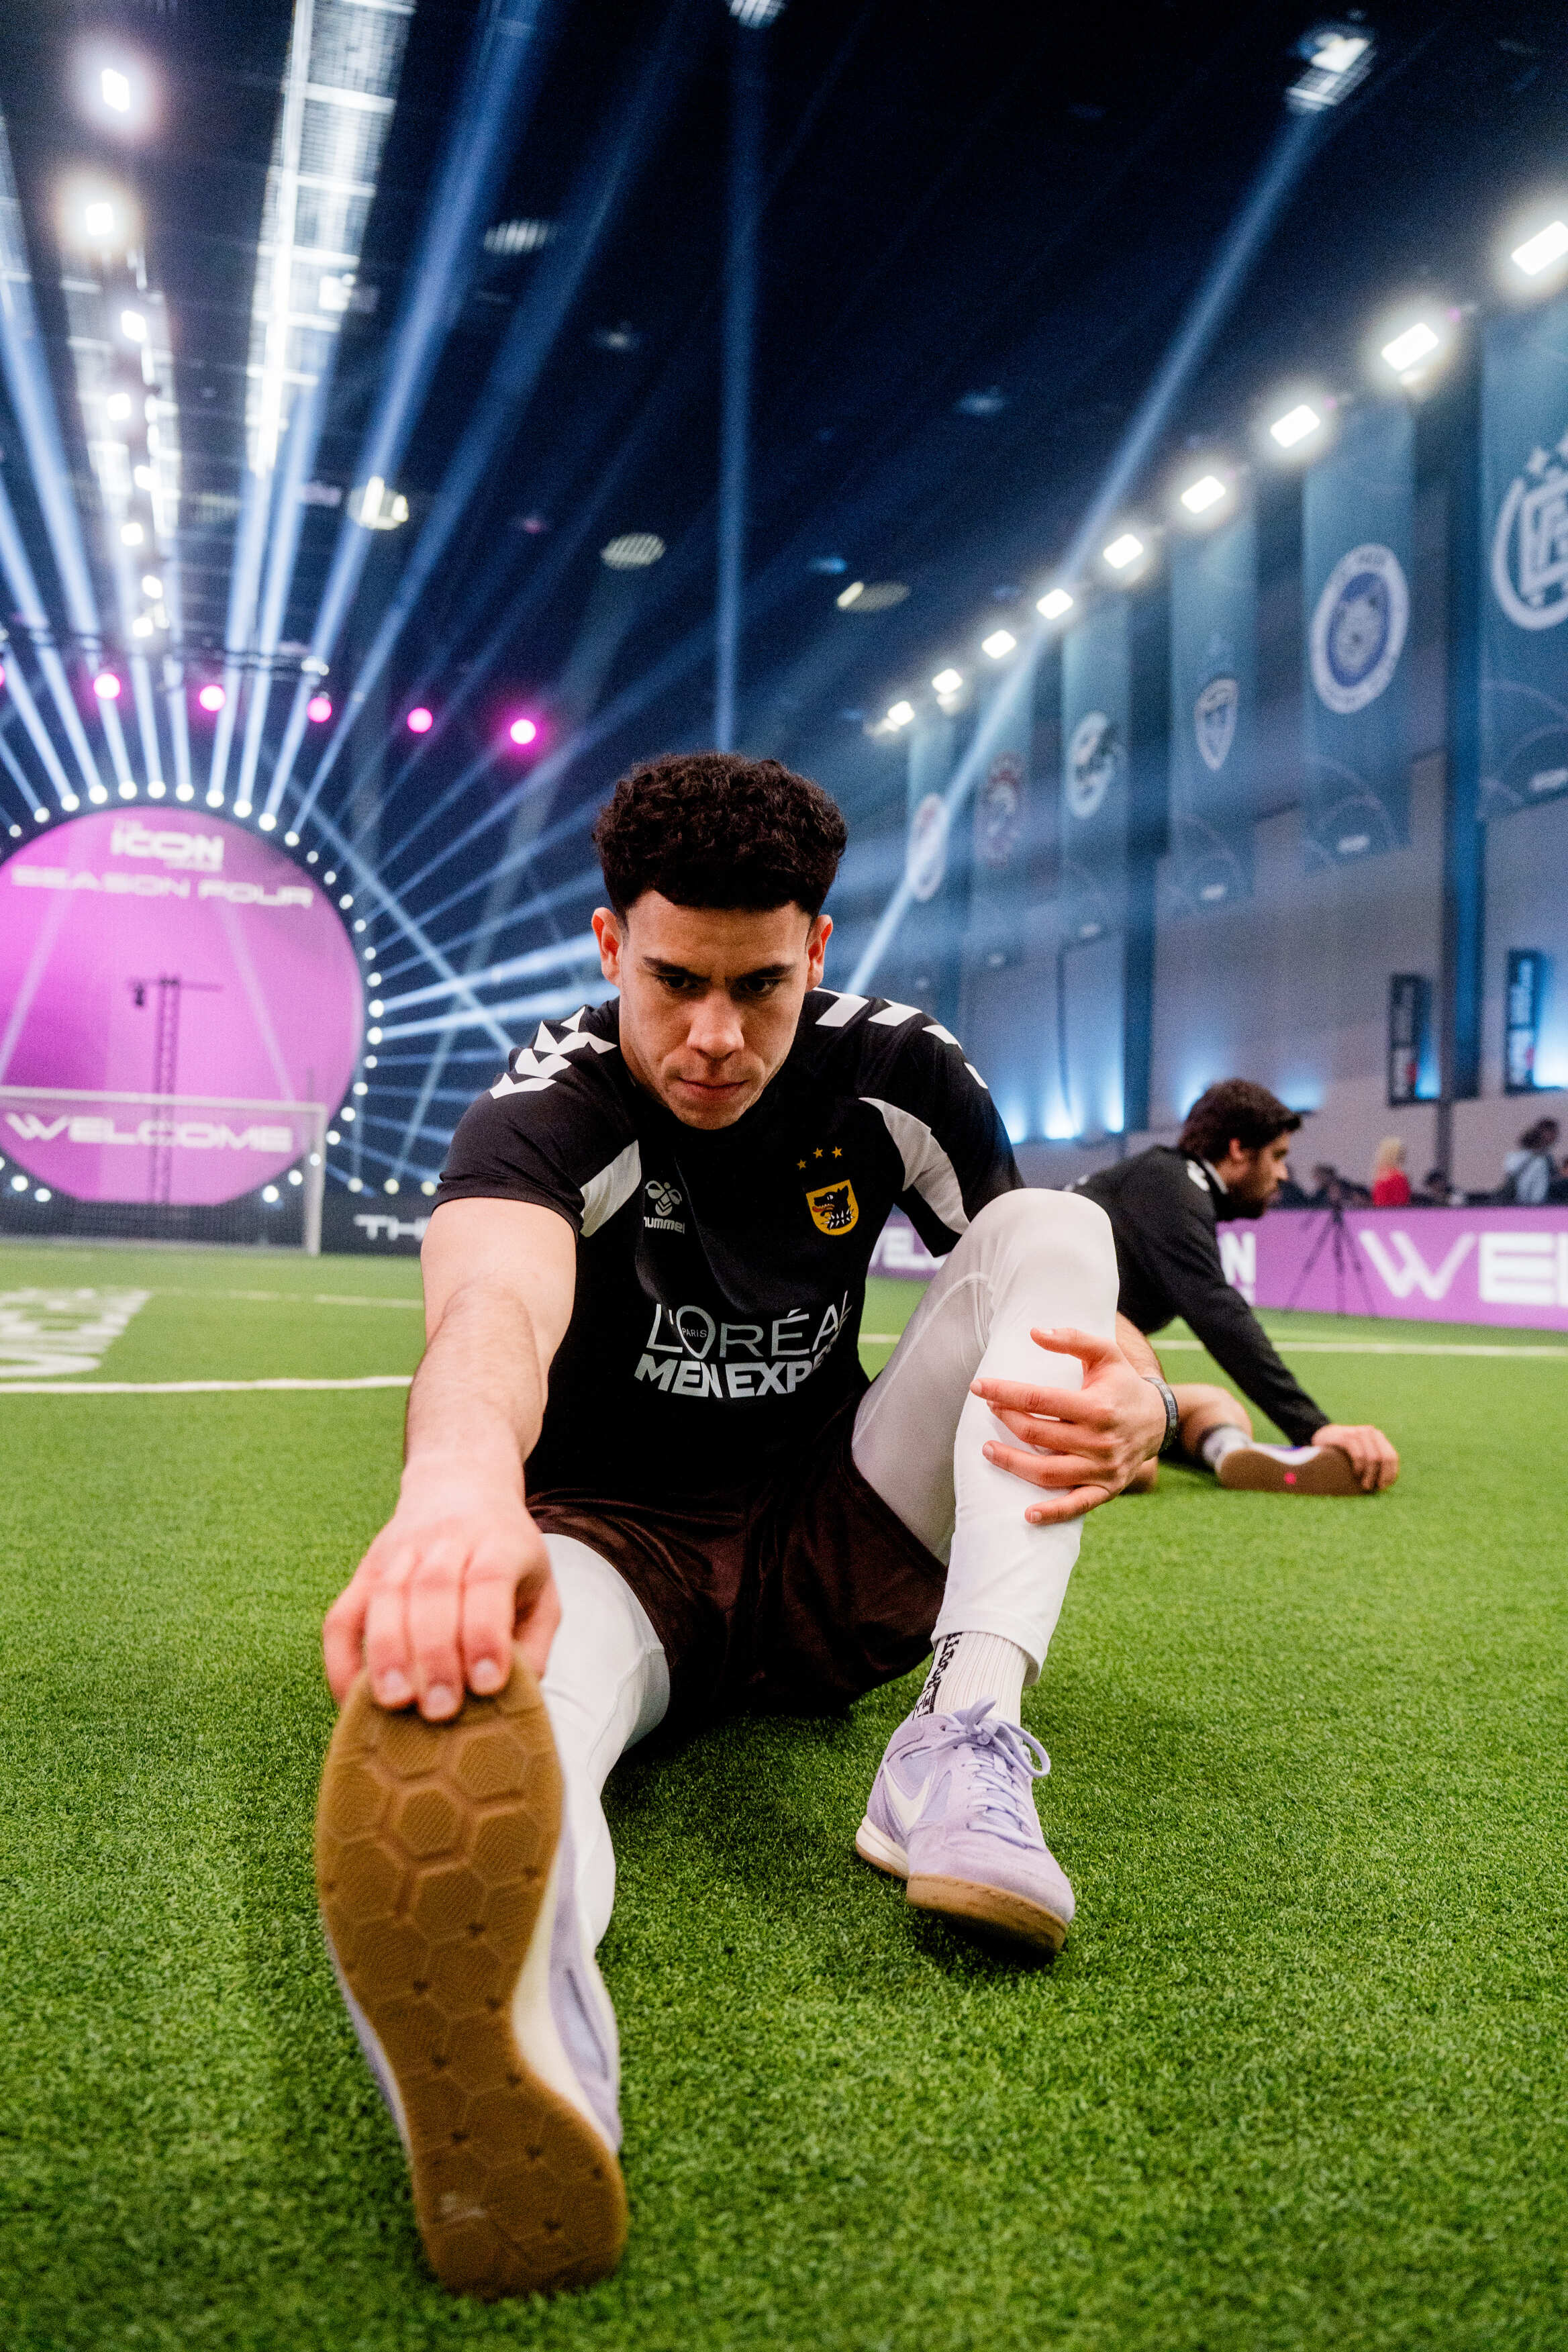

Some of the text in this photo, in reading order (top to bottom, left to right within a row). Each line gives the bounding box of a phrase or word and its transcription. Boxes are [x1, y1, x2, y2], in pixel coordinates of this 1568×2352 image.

[11, 865, 314, 908] SEASON FOUR
[5, 1112, 293, 1153] WELCOME
[353, 1214, 431, 1241] TH
[1359, 1230, 1568, 1308] WE
[646, 1289, 852, 1359] L'ORÉA
[682, 1327, 707, 1338] PARIS
[634, 1353, 724, 1398] MEN
